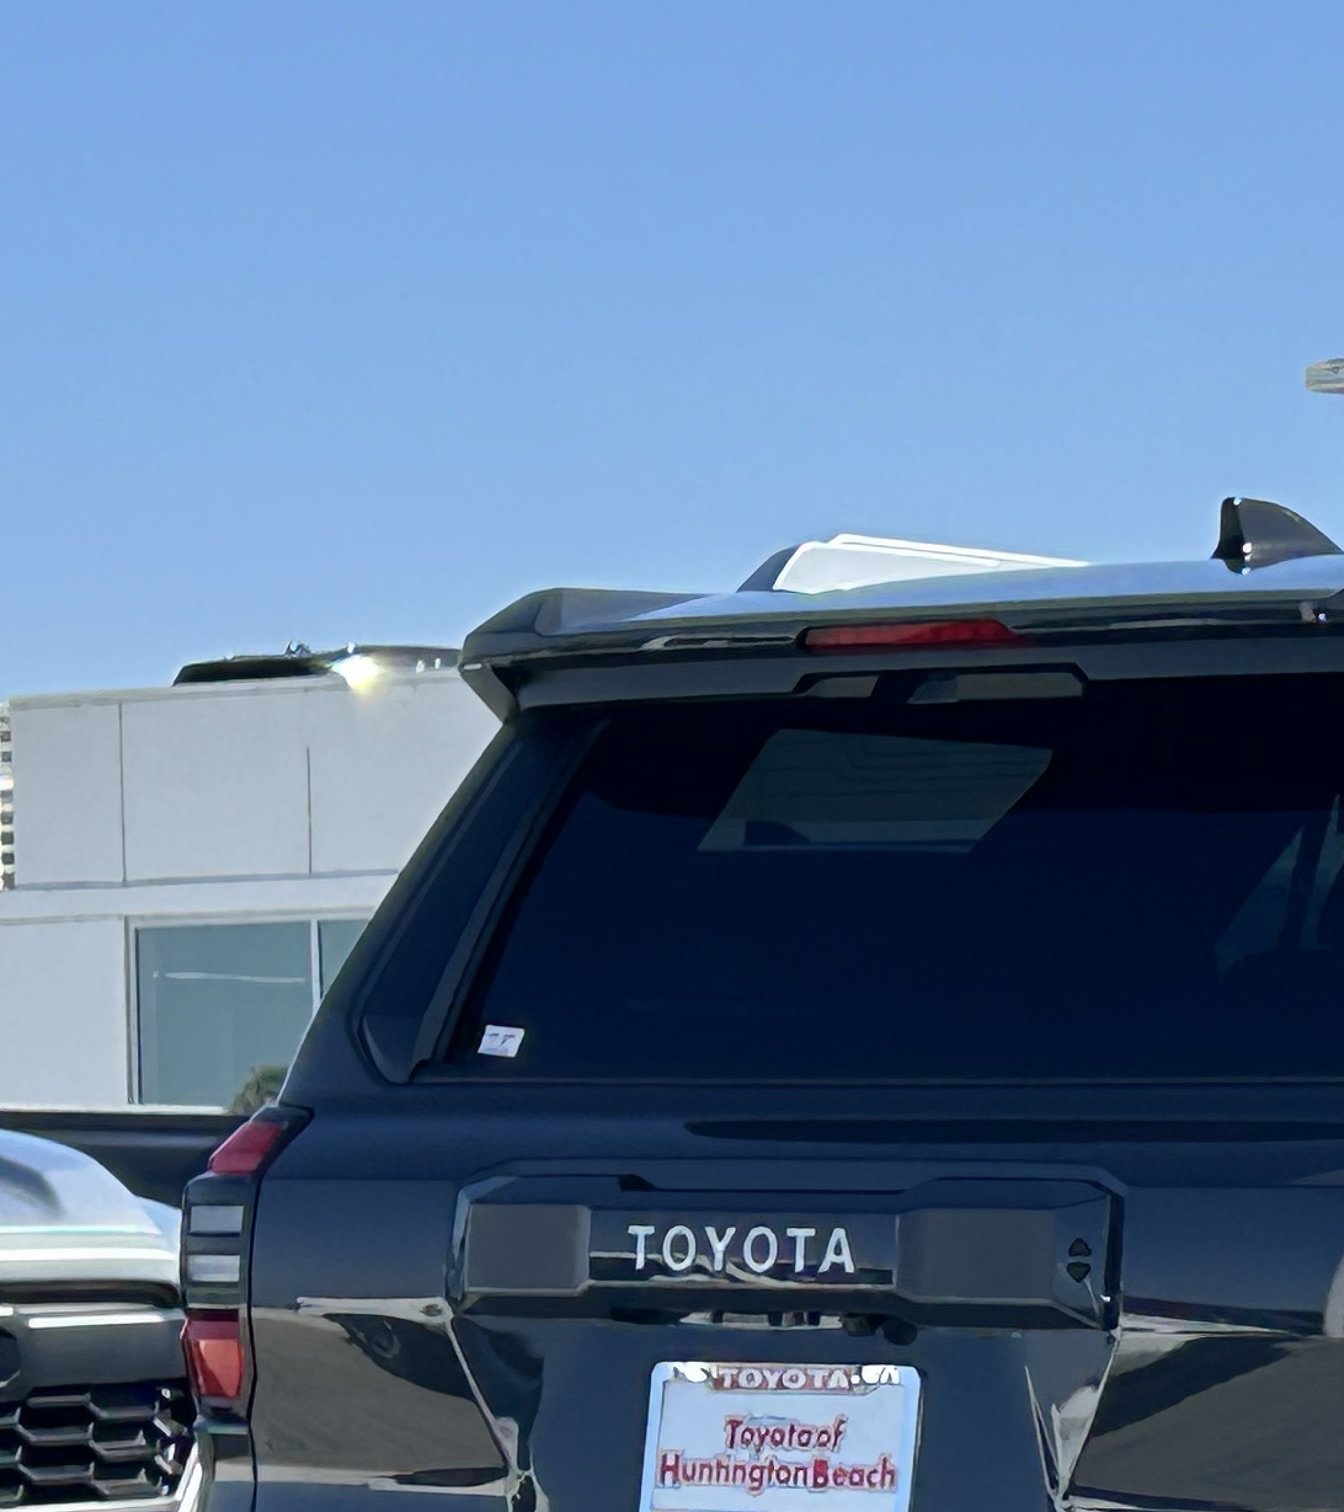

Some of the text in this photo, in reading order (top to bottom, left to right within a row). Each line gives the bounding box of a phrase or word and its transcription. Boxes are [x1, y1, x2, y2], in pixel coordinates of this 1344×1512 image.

[628, 1225, 855, 1273] TOYOTA
[725, 1414, 846, 1452] Toyota of
[660, 1453, 896, 1493] Huntington Beach
